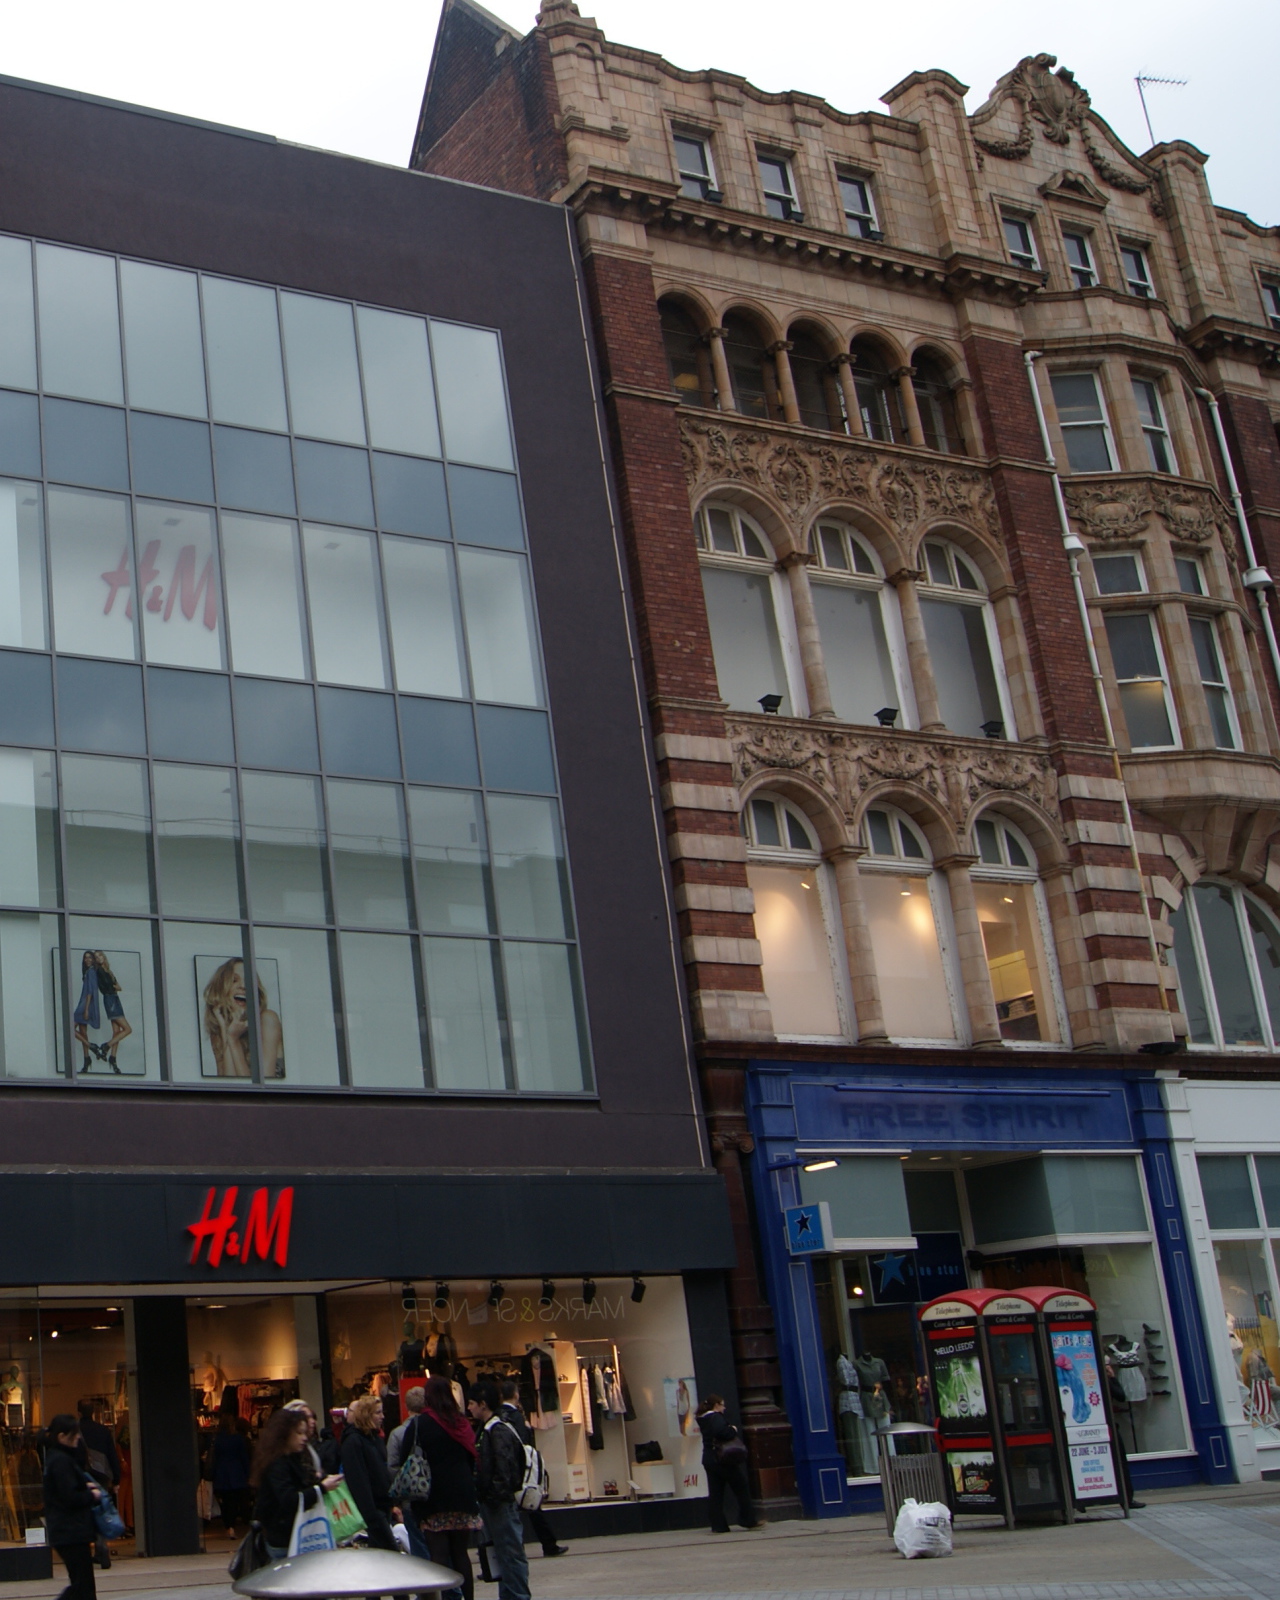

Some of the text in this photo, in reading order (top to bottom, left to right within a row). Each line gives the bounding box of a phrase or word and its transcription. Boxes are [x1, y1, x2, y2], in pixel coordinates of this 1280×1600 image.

[101, 540, 224, 631] H&M
[841, 1102, 1089, 1129] FREE SPIRIT
[186, 1186, 294, 1268] H&M
[907, 1263, 959, 1277] bue star
[996, 1303, 1022, 1311] Telephone
[1055, 1300, 1080, 1308] Telephone
[935, 1307, 961, 1316] Telephone
[1078, 1447, 1090, 1456] JUNE
[1097, 1445, 1108, 1454] JULY
